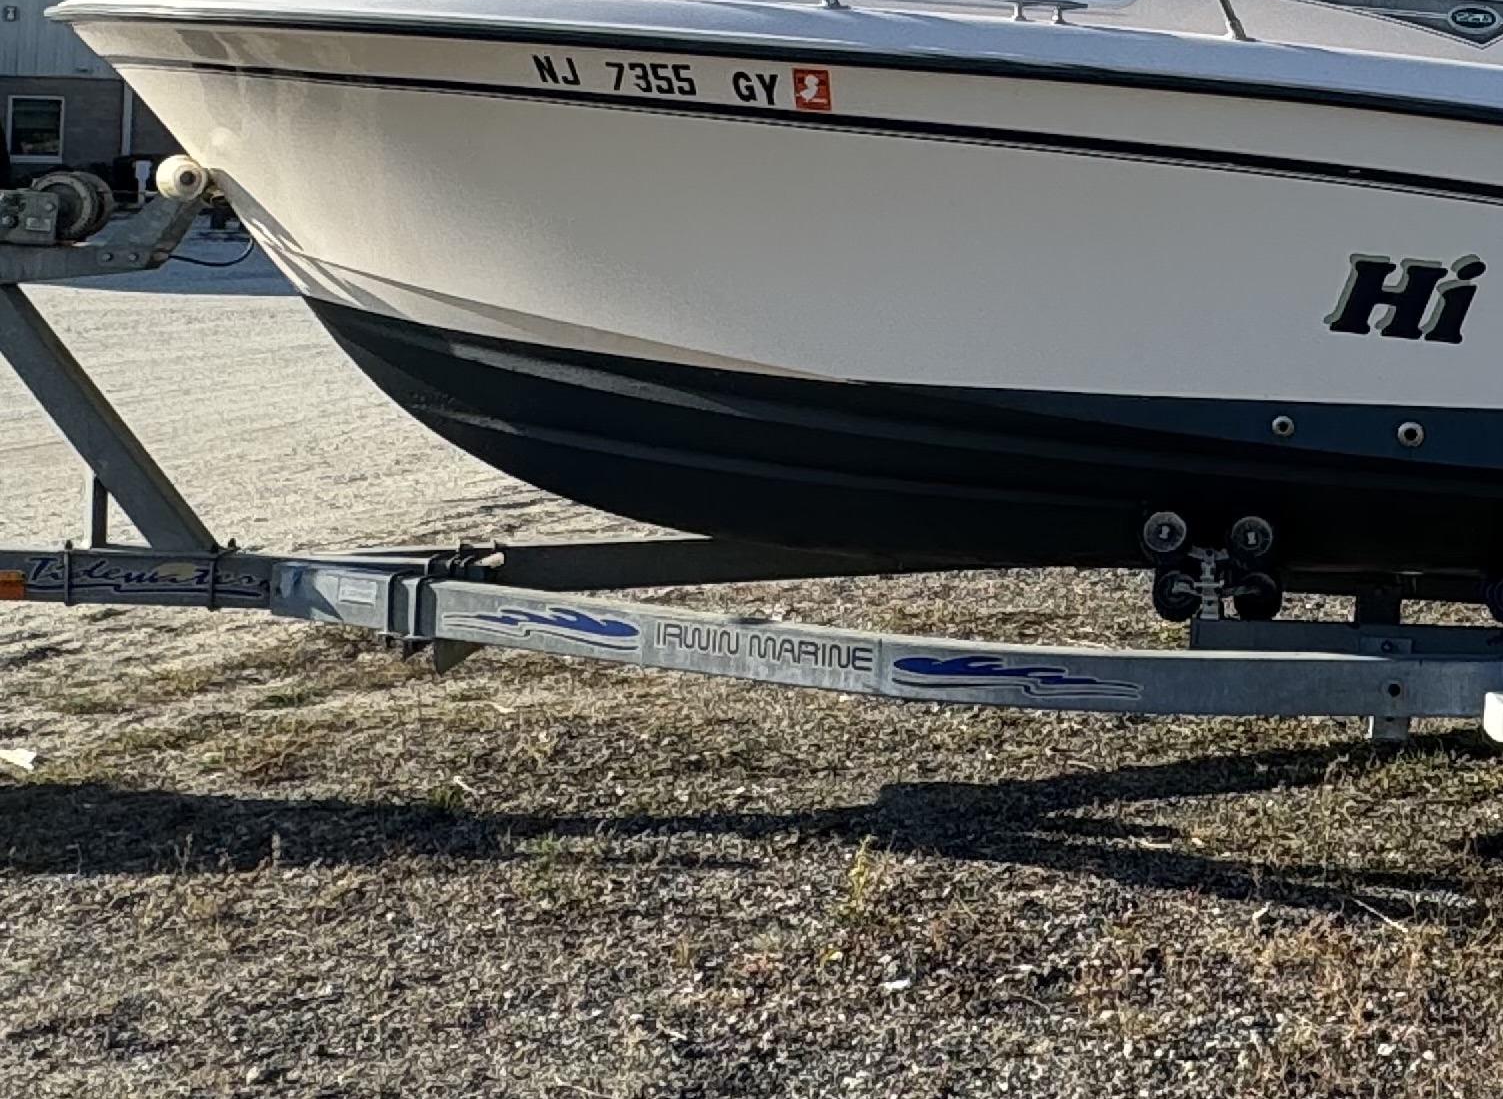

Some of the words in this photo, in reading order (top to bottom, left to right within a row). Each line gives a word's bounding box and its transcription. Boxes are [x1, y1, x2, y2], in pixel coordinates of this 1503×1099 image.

[532, 55, 581, 86] NJ
[605, 61, 697, 96] 7355
[732, 71, 778, 105] GY
[1324, 254, 1486, 344] Hi
[656, 621, 739, 654] IRWIN
[750, 634, 873, 671] MARINE
